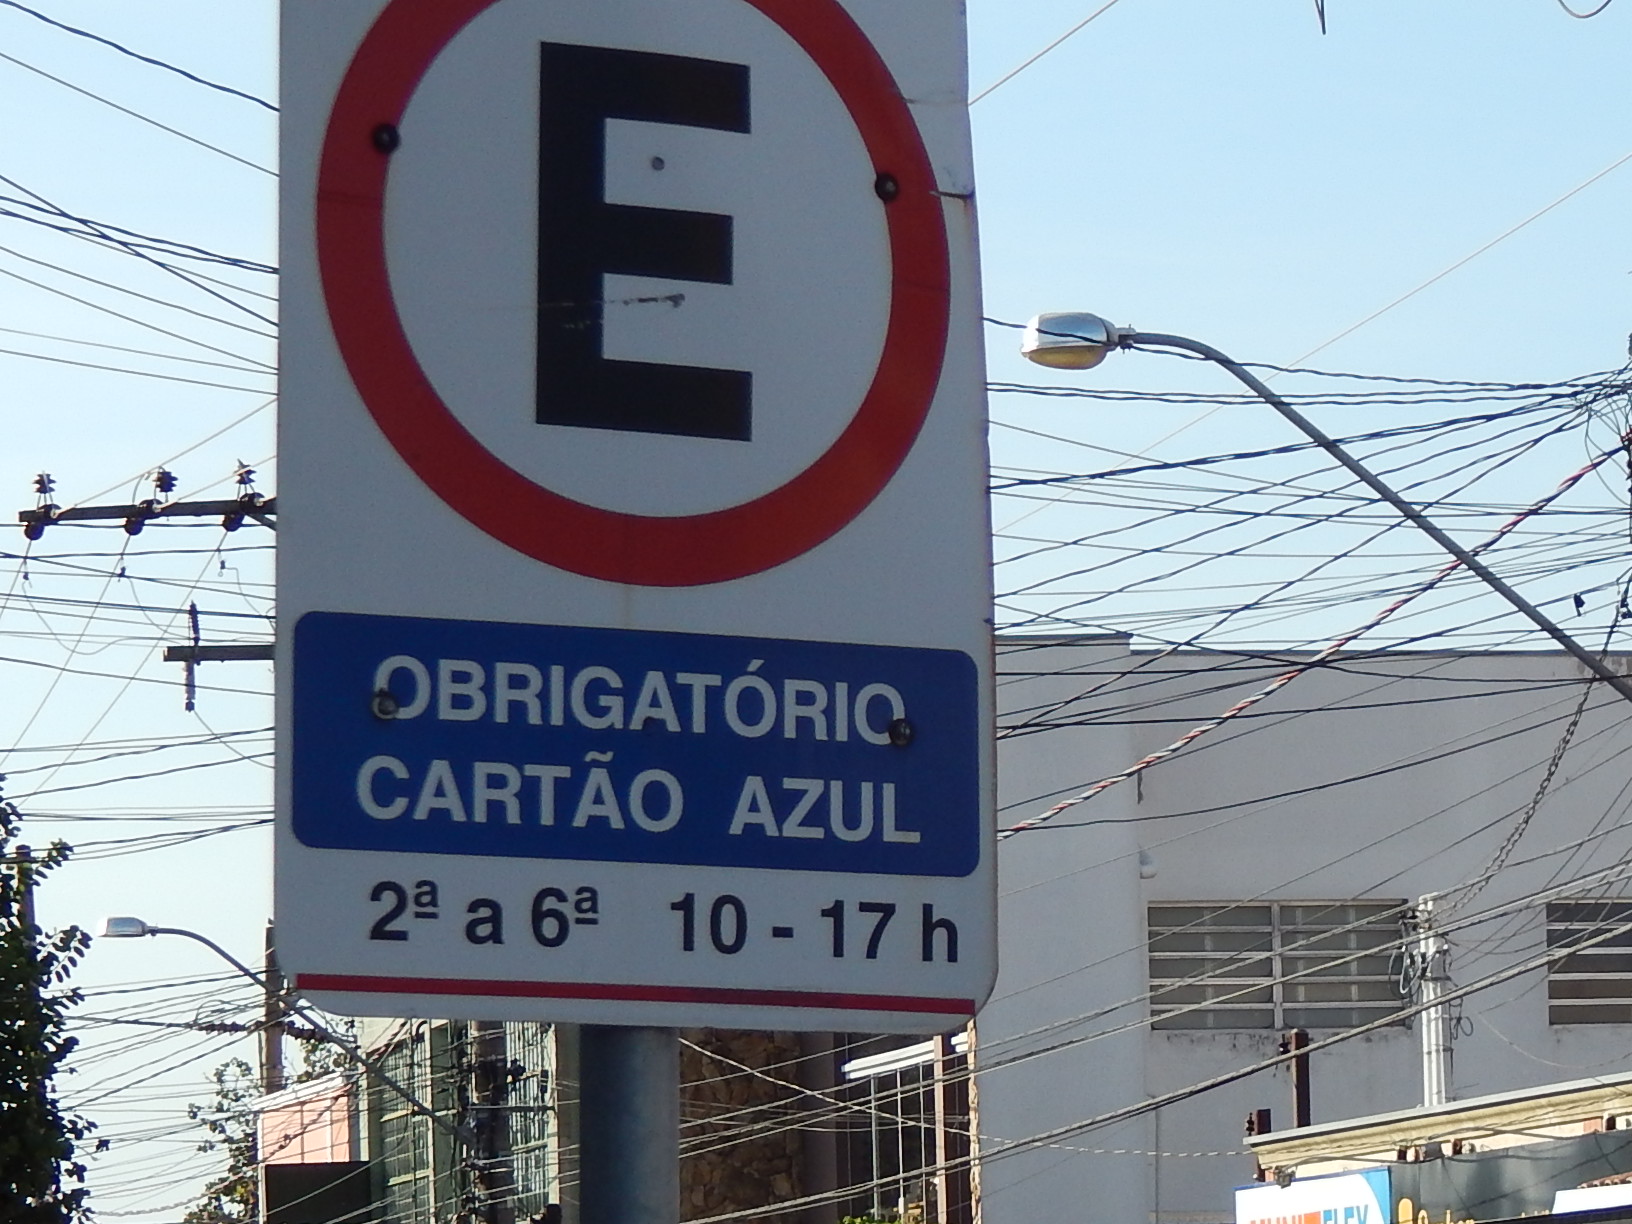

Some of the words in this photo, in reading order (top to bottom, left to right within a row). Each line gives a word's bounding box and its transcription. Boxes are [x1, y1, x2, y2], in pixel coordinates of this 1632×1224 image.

[536, 41, 752, 442] E
[374, 653, 907, 746] OBRIGATÓRIO
[356, 750, 684, 833] CARTÃO
[728, 775, 921, 844] AZUL
[464, 898, 505, 945] a
[670, 892, 749, 955] 10
[820, 901, 896, 960] 17
[920, 902, 960, 963] h
